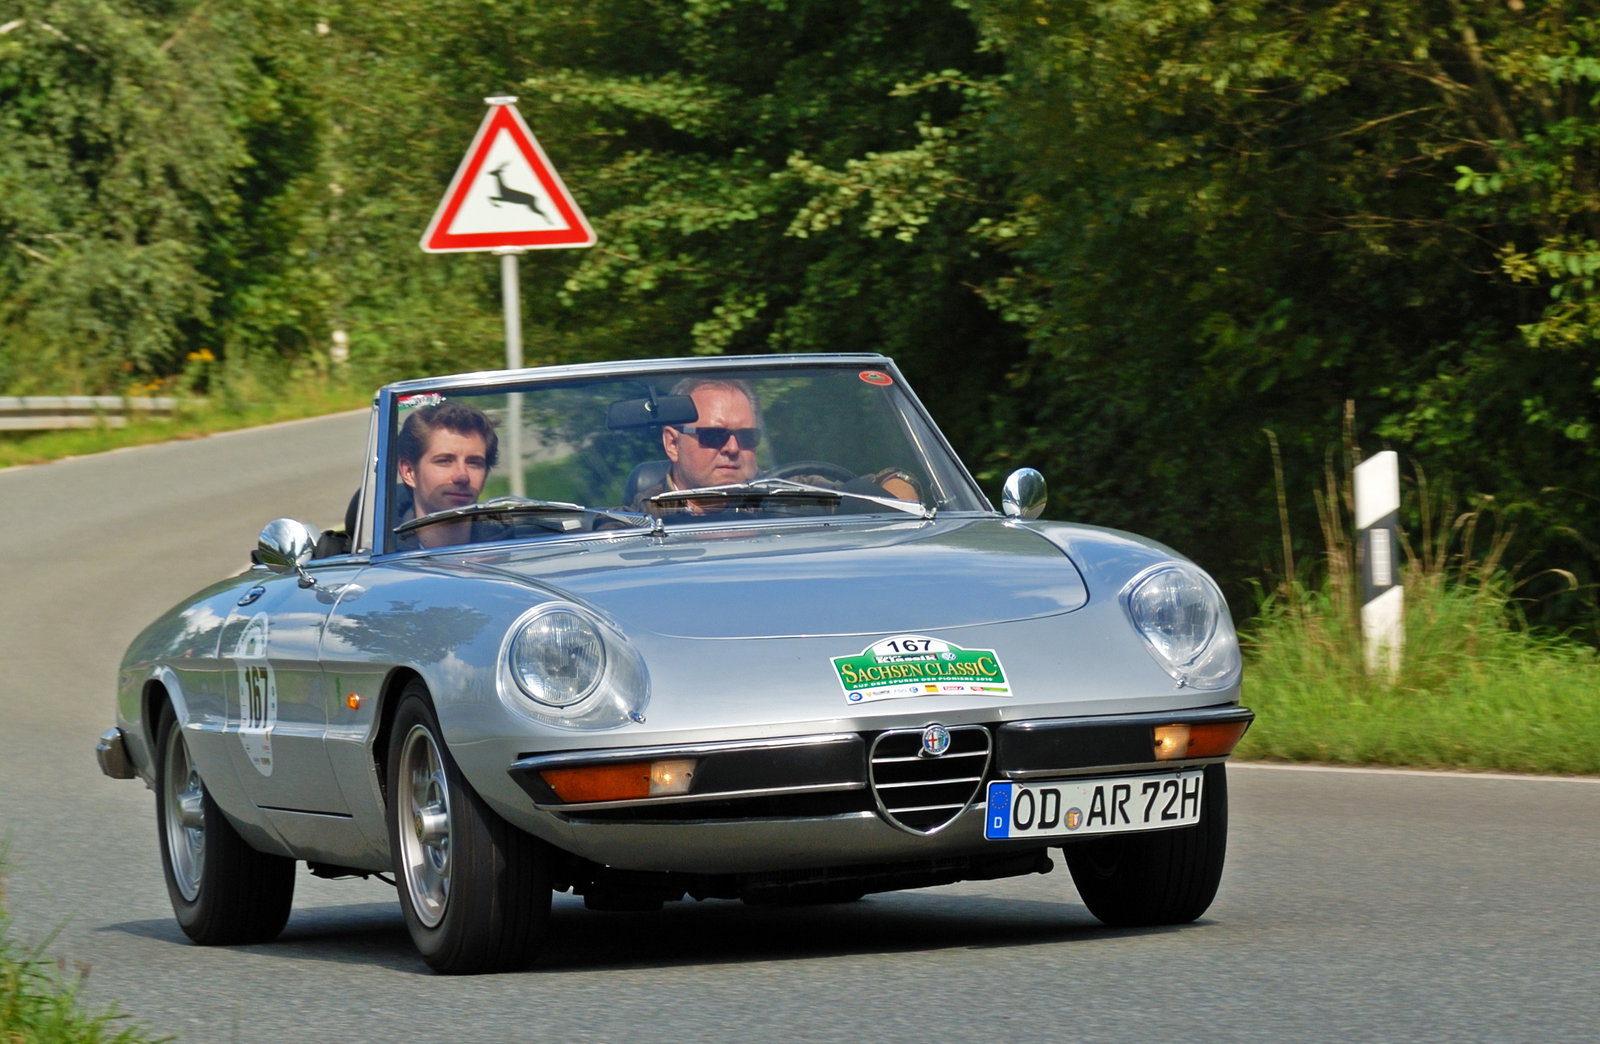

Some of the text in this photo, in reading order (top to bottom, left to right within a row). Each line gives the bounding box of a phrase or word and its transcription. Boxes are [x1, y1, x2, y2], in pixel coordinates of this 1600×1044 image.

[887, 640, 931, 653] 167
[841, 656, 998, 684] SACHSEN CLASSIC
[245, 666, 268, 728] 167
[1013, 777, 1200, 831] OD AR 72H
[994, 817, 1002, 828] D
